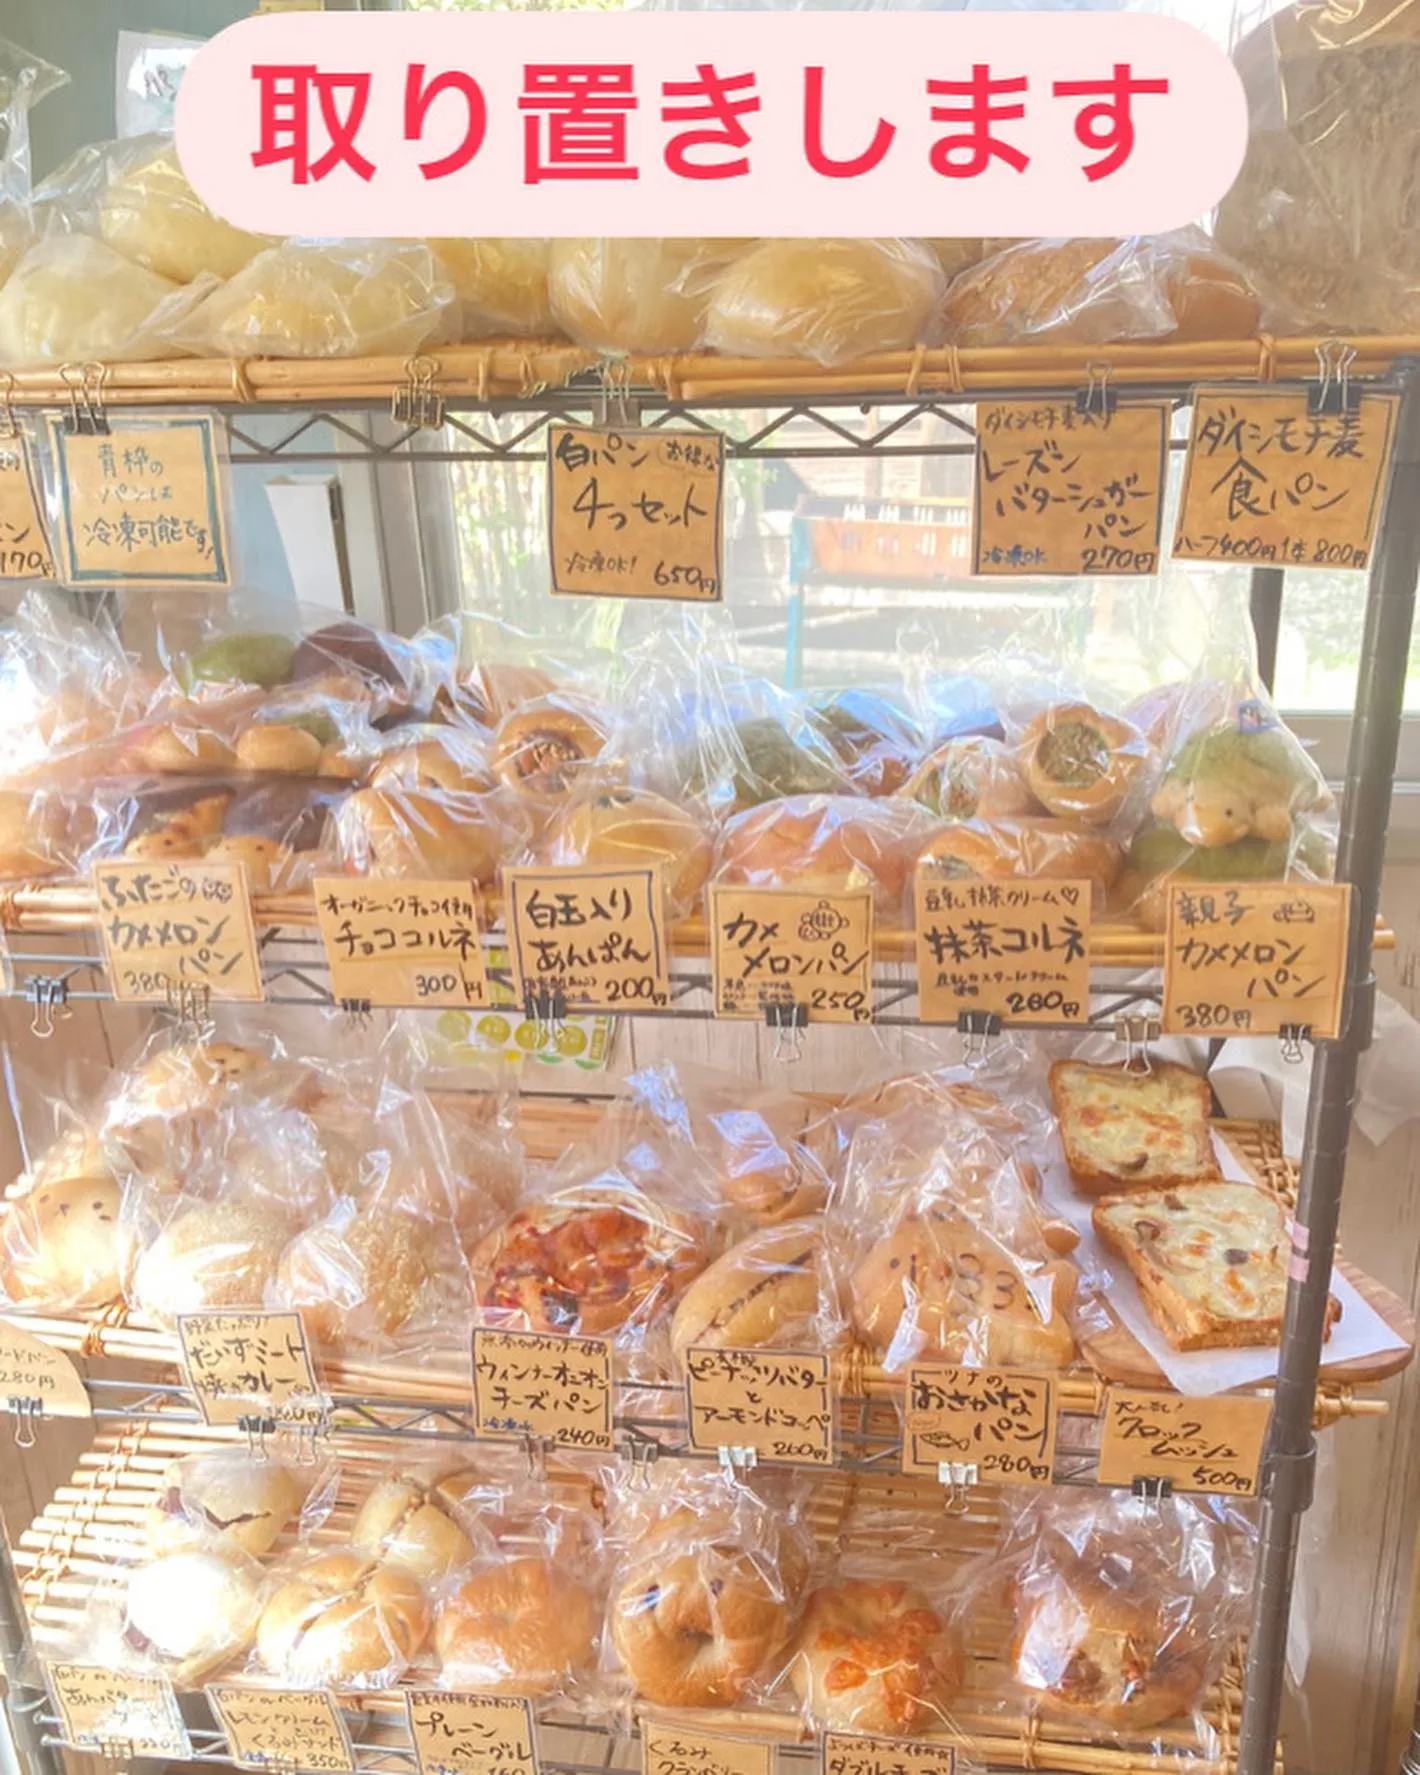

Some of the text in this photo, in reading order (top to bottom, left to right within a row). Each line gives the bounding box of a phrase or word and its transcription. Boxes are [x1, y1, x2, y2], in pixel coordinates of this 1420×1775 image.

[1198, 404, 1365, 459] ダイシモチ麦
[556, 432, 649, 472] 白パン
[982, 440, 1081, 483] レーズン
[101, 482, 172, 504] パンは
[572, 476, 708, 531] 4つセット
[996, 473, 1153, 515] バターシュガー
[1210, 455, 1350, 521] 食パン
[1084, 513, 1147, 540] パン
[1081, 546, 1154, 573] 270円
[653, 561, 716, 595] 650円
[526, 888, 633, 929] 白玉入り
[1177, 890, 1255, 929] 親子
[107, 915, 231, 952] カメメロン
[334, 920, 475, 961] チョココルネ
[722, 911, 780, 949] カメ
[923, 915, 1086, 965] 抹茶コルネ
[179, 947, 244, 977] パン
[527, 931, 652, 973] あんぱん
[742, 940, 870, 979] メロンパン
[1176, 937, 1307, 971] カメメロン
[604, 976, 668, 1007] 200円
[1246, 967, 1327, 999] パン
[811, 987, 872, 1024] 250円
[1175, 1003, 1252, 1030] 380円
[943, 1369, 1003, 1387] ツナの
[492, 1385, 602, 1415] チーズパン
[746, 1390, 762, 1404] と
[911, 1380, 1037, 1417] おさかな
[556, 1427, 611, 1448] 240円
[973, 1416, 1044, 1442] パン
[1118, 1417, 1202, 1440] クロック
[1151, 1440, 1239, 1459] ムッシュ
[983, 1453, 1049, 1480] 280円
[1192, 1464, 1252, 1491] 500円
[415, 1710, 497, 1737] プレーン
[451, 1741, 533, 1761] ベーグル
[649, 1740, 712, 1760] くるみ
